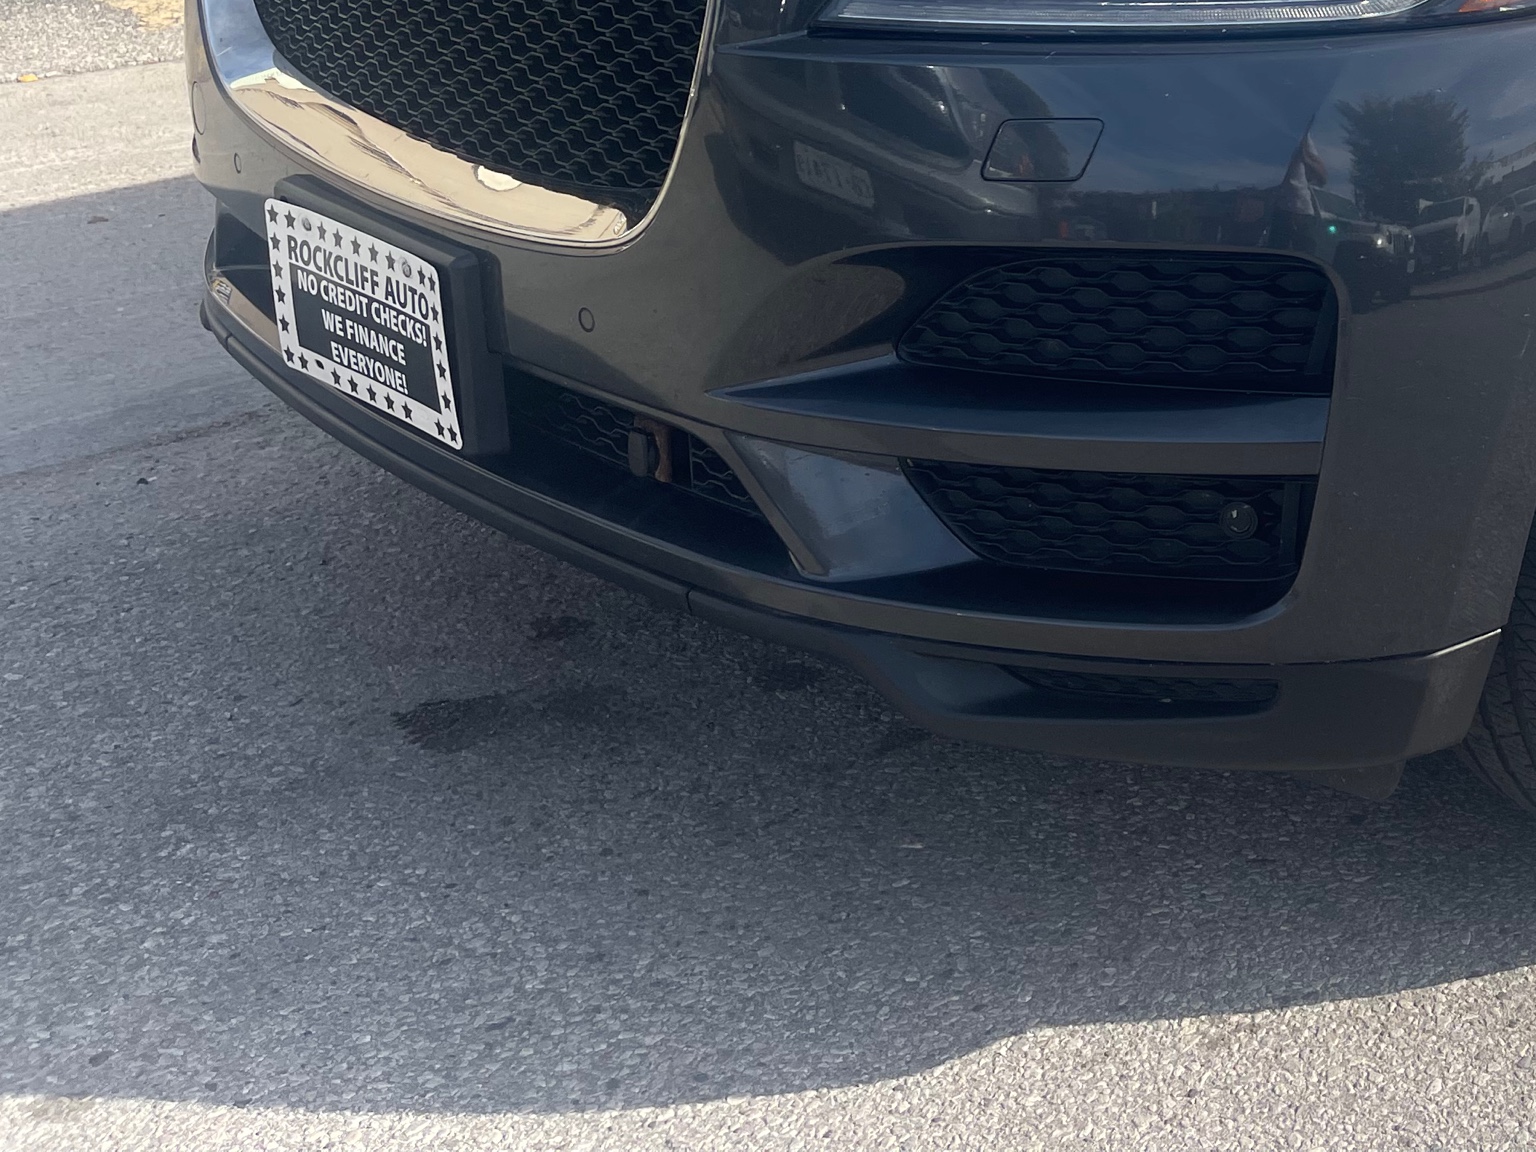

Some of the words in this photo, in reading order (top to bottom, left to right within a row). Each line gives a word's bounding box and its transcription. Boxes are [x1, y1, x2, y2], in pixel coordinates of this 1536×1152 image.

[287, 234, 379, 296] ROCKCLIFF
[385, 276, 429, 320] AUTO
[297, 269, 318, 296] NO
[320, 277, 368, 318] CREDIT
[371, 303, 428, 347] CHECKS!
[321, 308, 344, 337] WE
[345, 319, 406, 365] FINANCE
[331, 341, 408, 395] EVERYONE!
